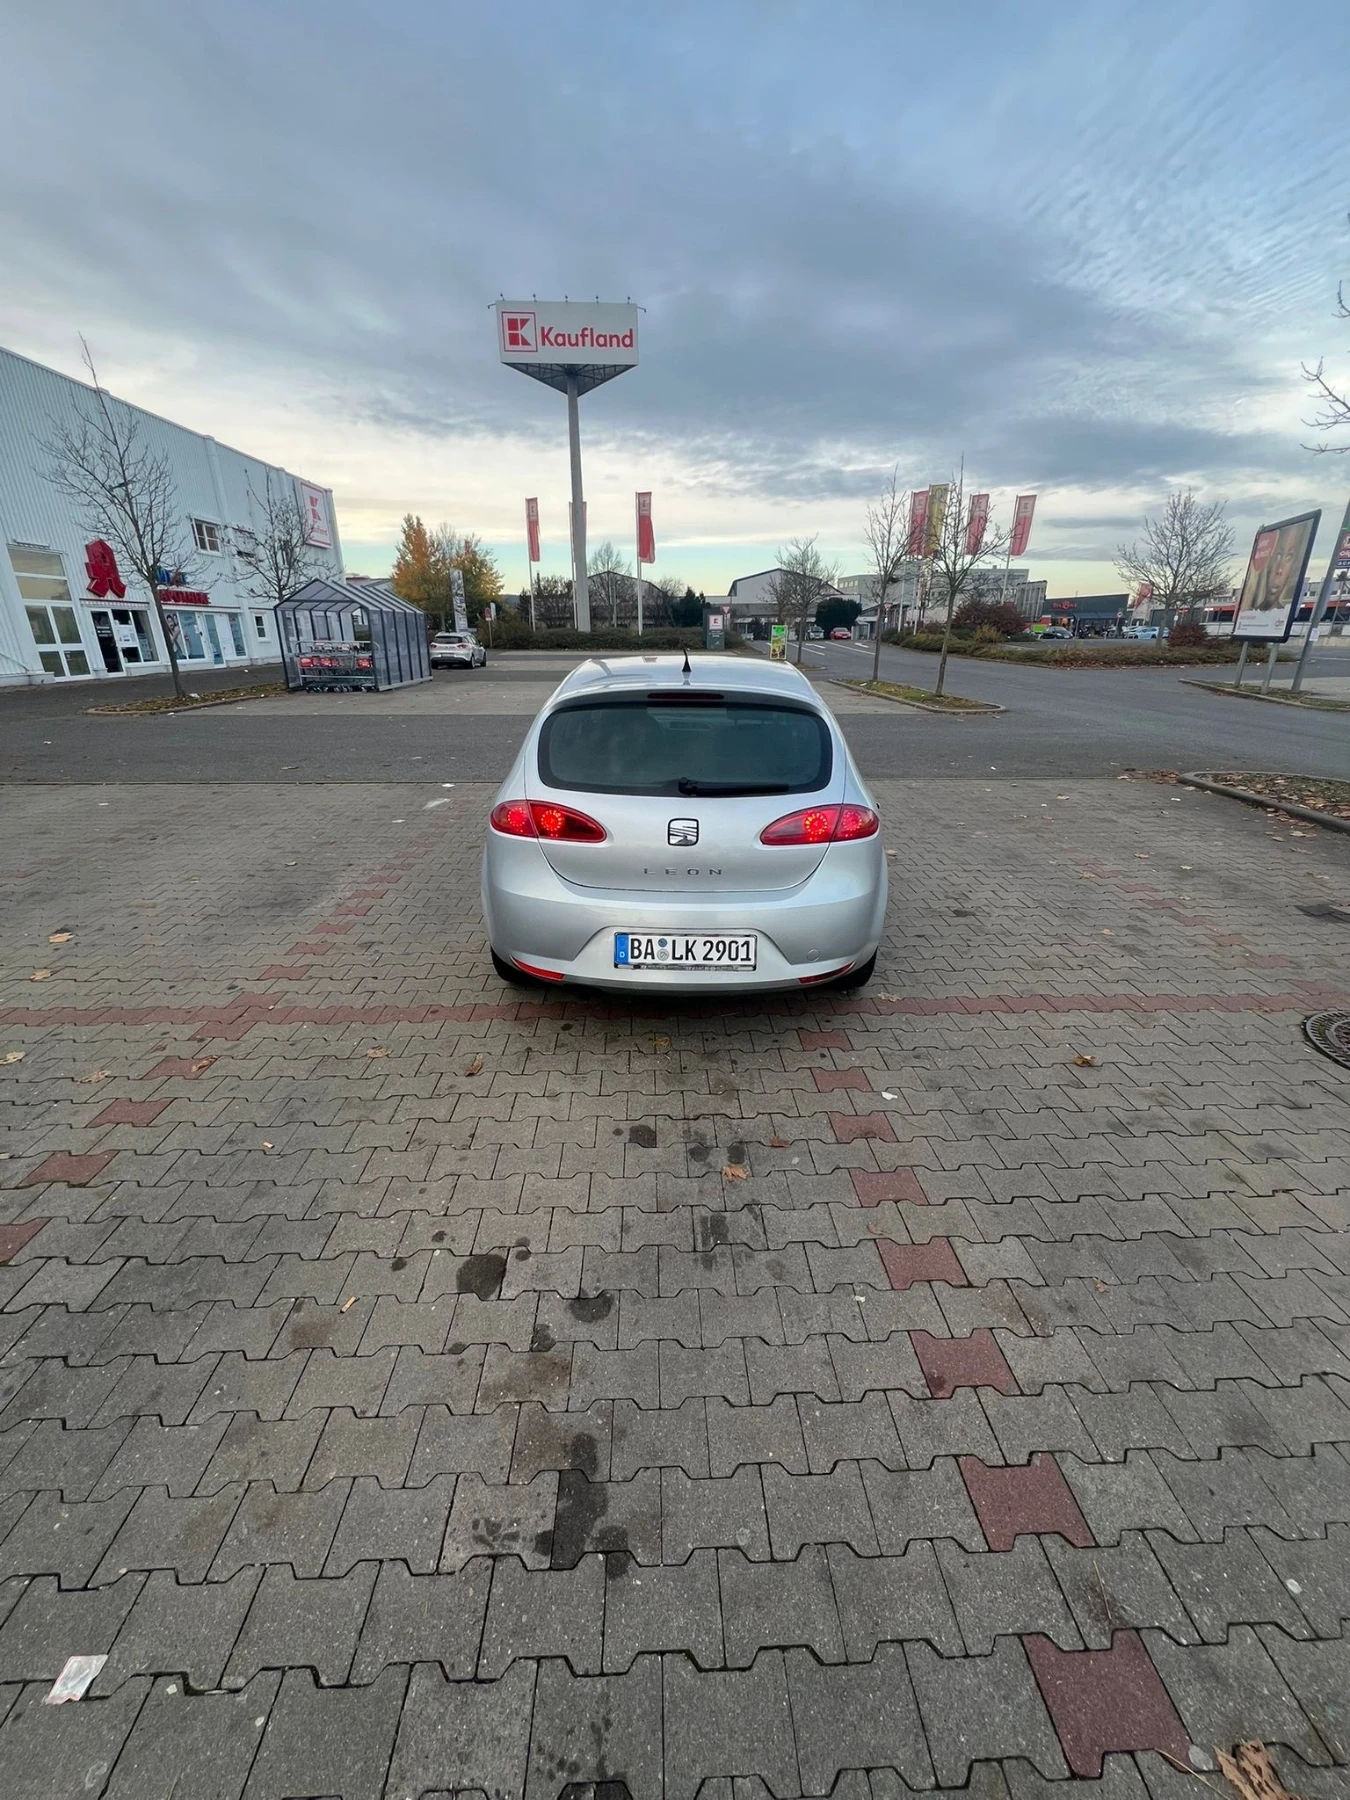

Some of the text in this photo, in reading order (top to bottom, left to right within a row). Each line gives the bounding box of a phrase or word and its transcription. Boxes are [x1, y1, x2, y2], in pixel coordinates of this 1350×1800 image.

[540, 326, 634, 348] Kaufland
[643, 866, 722, 876] LEON
[630, 938, 655, 960] BA
[671, 939, 697, 961] LK
[702, 940, 752, 962] 2901
